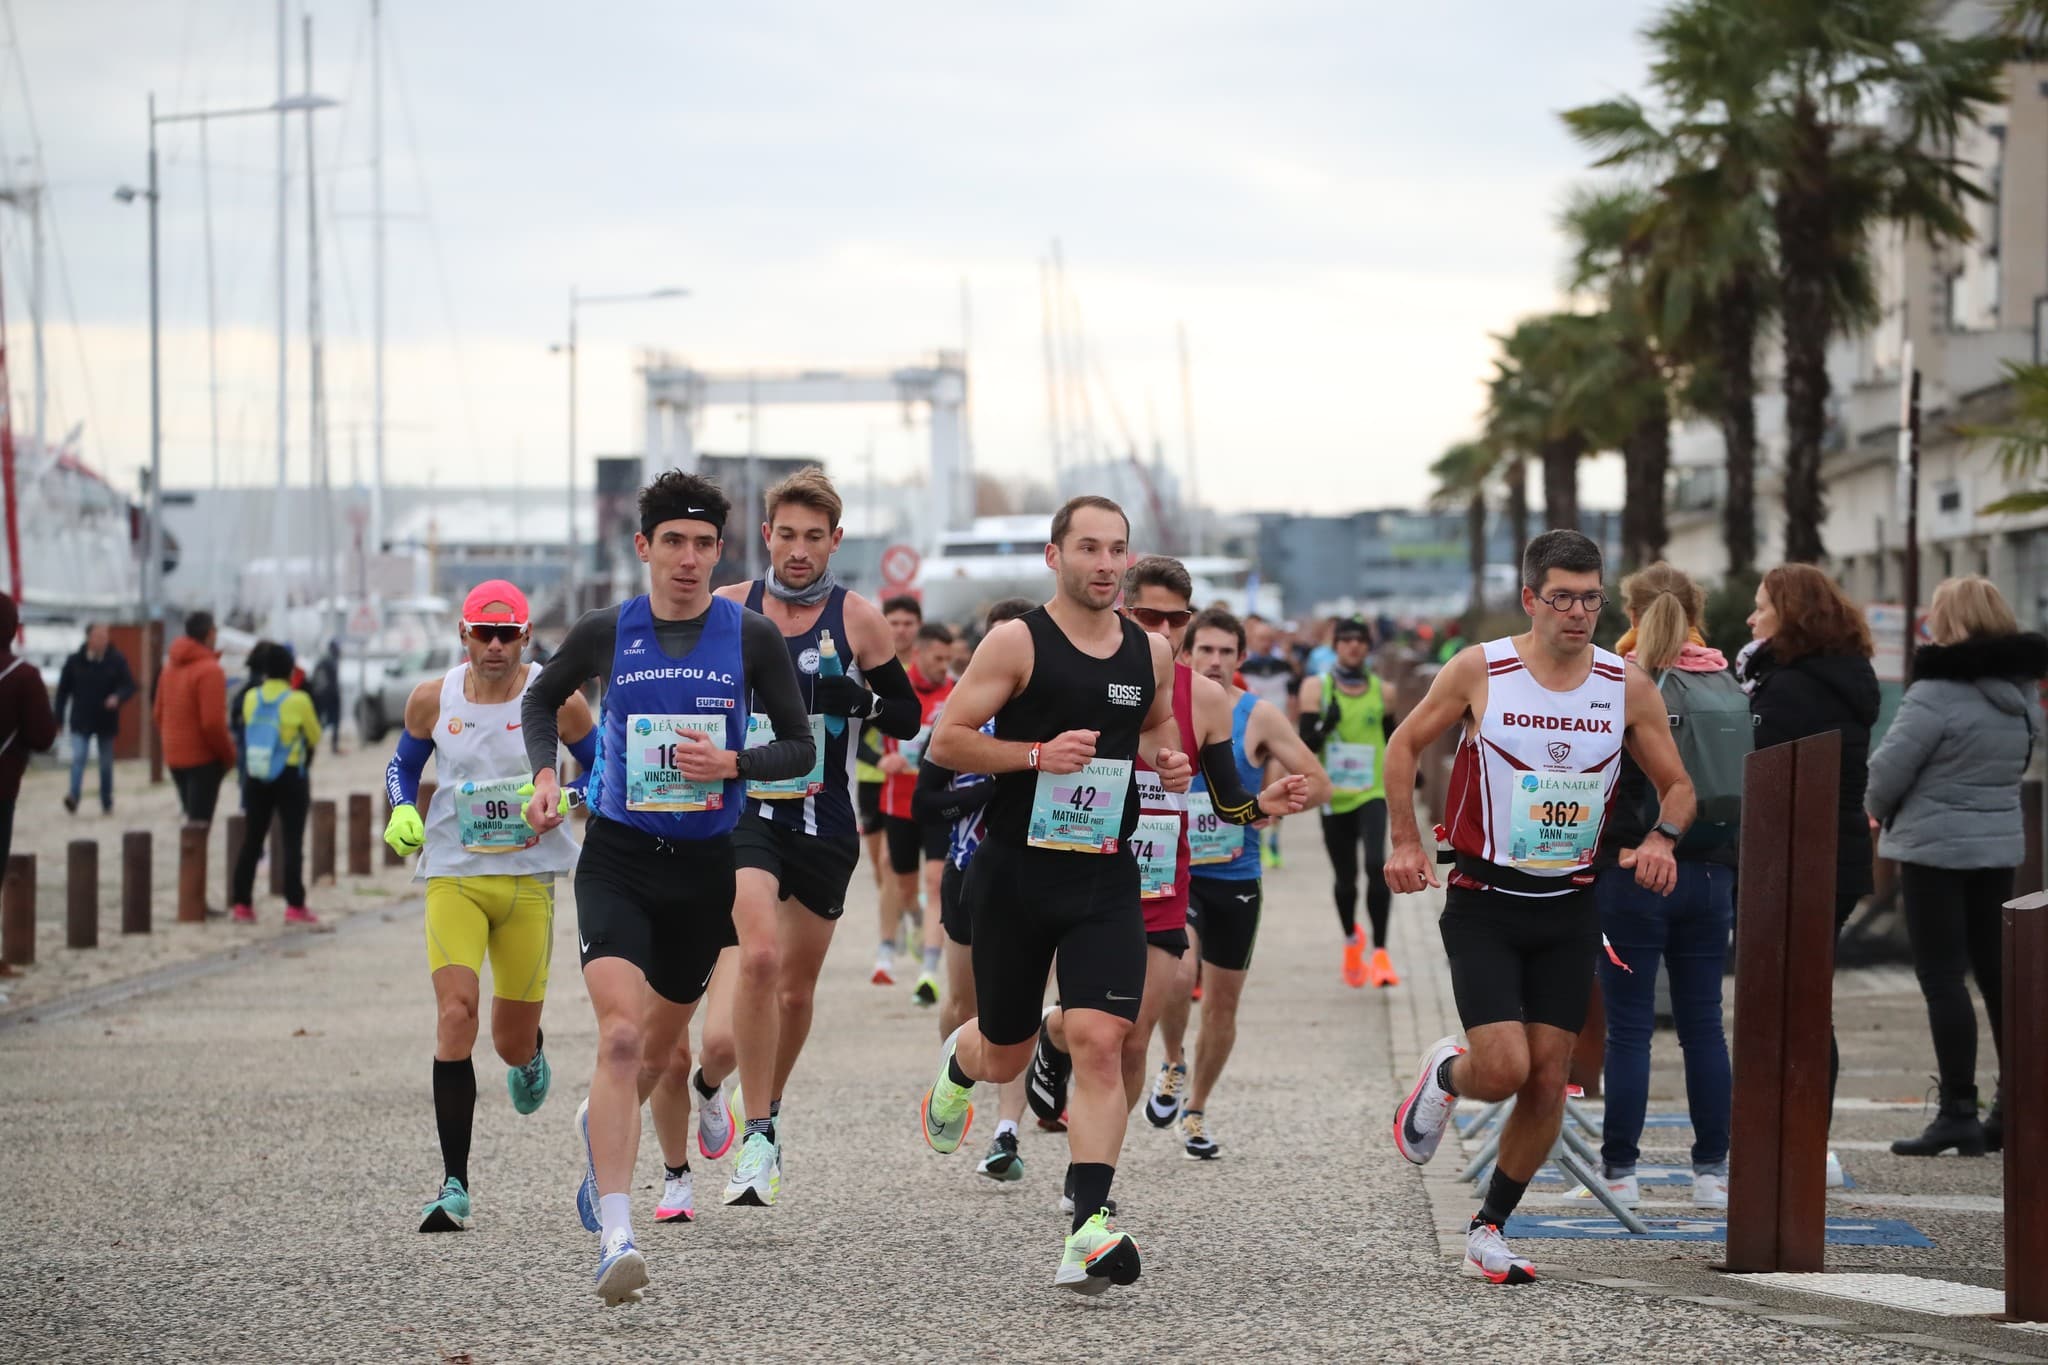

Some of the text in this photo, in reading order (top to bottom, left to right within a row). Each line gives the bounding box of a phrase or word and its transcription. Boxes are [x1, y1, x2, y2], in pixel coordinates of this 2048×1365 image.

[616, 668, 735, 686] CARQUEFOU A.C.
[1108, 683, 1141, 701] GOSSE
[1503, 713, 1612, 733] BORDEAUX
[658, 743, 677, 770] 16
[644, 770, 682, 782] VINCENT
[1087, 766, 1125, 777] NATURE
[1540, 777, 1599, 790] LÉA NATURE
[1070, 785, 1097, 812] 42
[485, 799, 509, 820] 96
[1052, 809, 1090, 824] MATHIEU
[1542, 801, 1579, 827] 362
[473, 820, 503, 830] ARNAUD
[1141, 822, 1175, 831] NATURE
[1197, 813, 1217, 833] 89
[1539, 828, 1563, 840] YANN
[1128, 840, 1154, 863] 74
